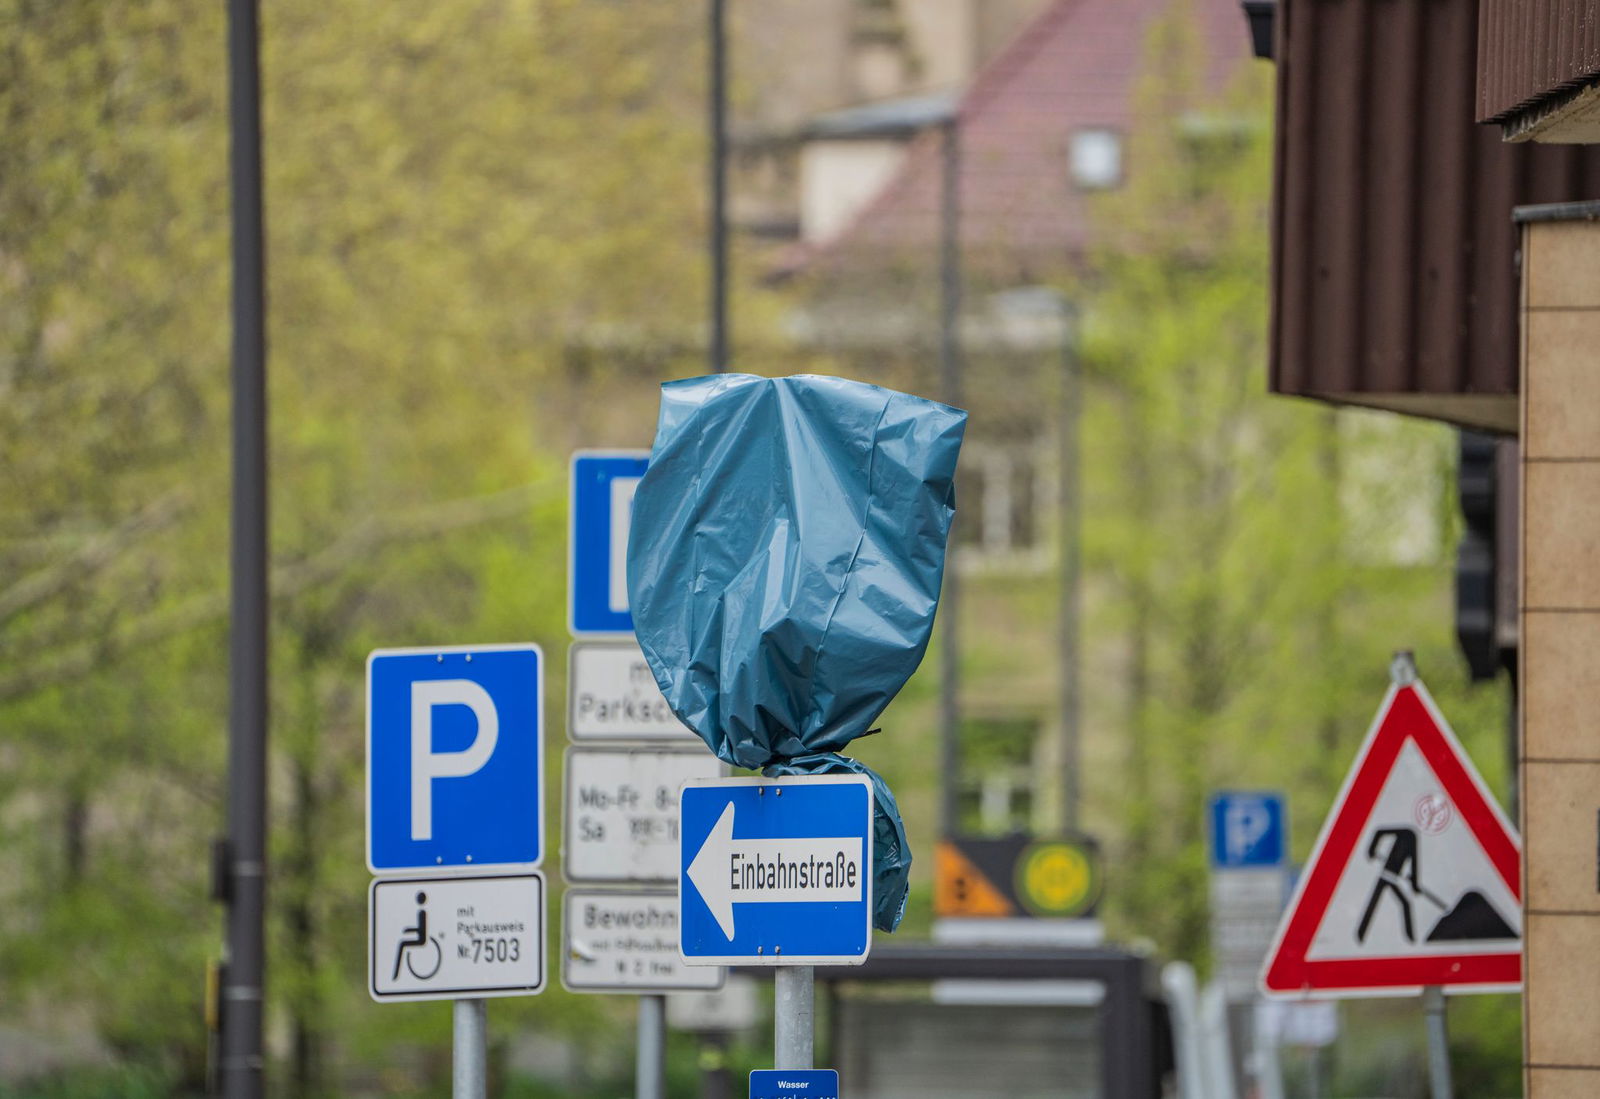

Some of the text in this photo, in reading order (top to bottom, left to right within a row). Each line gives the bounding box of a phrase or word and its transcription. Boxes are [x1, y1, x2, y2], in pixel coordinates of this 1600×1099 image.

[579, 693, 671, 722] Parksc
[411, 679, 499, 841] P
[579, 817, 606, 842] Sa
[731, 851, 857, 889] Einbahnstraße
[457, 905, 475, 917] mit
[584, 904, 678, 928] Bewohn
[472, 938, 520, 963] 7503
[777, 1080, 809, 1089] Wasser
